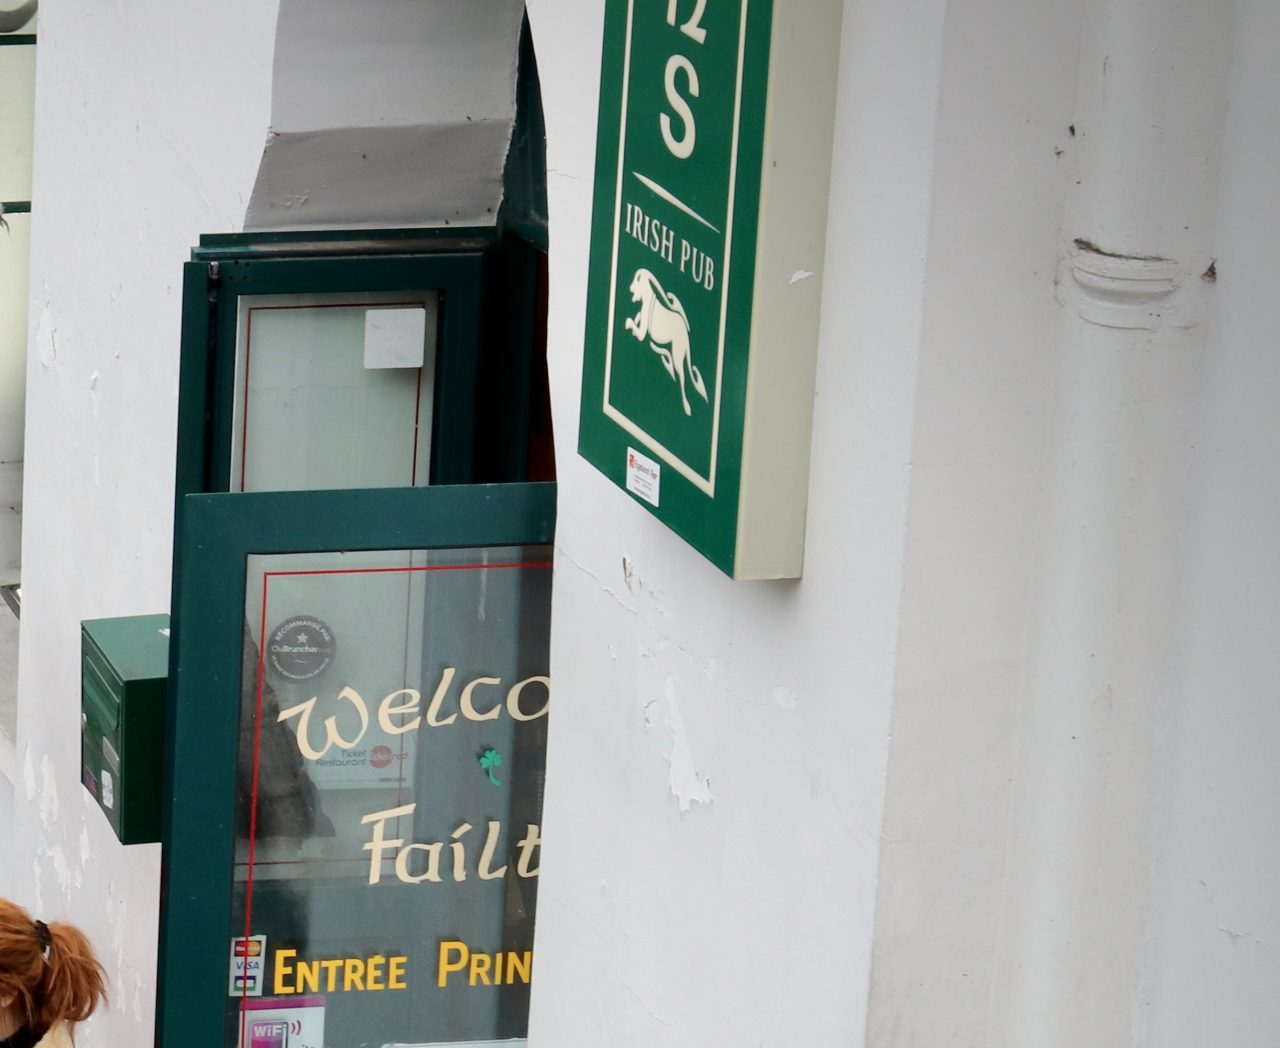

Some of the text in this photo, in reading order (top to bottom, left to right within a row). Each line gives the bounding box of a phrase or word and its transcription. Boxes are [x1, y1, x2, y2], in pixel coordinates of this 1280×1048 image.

[625, 203, 715, 291] IRISH PUB
[277, 666, 550, 761] Welco
[236, 960, 260, 970] VISA
[437, 941, 531, 988] PRIN
